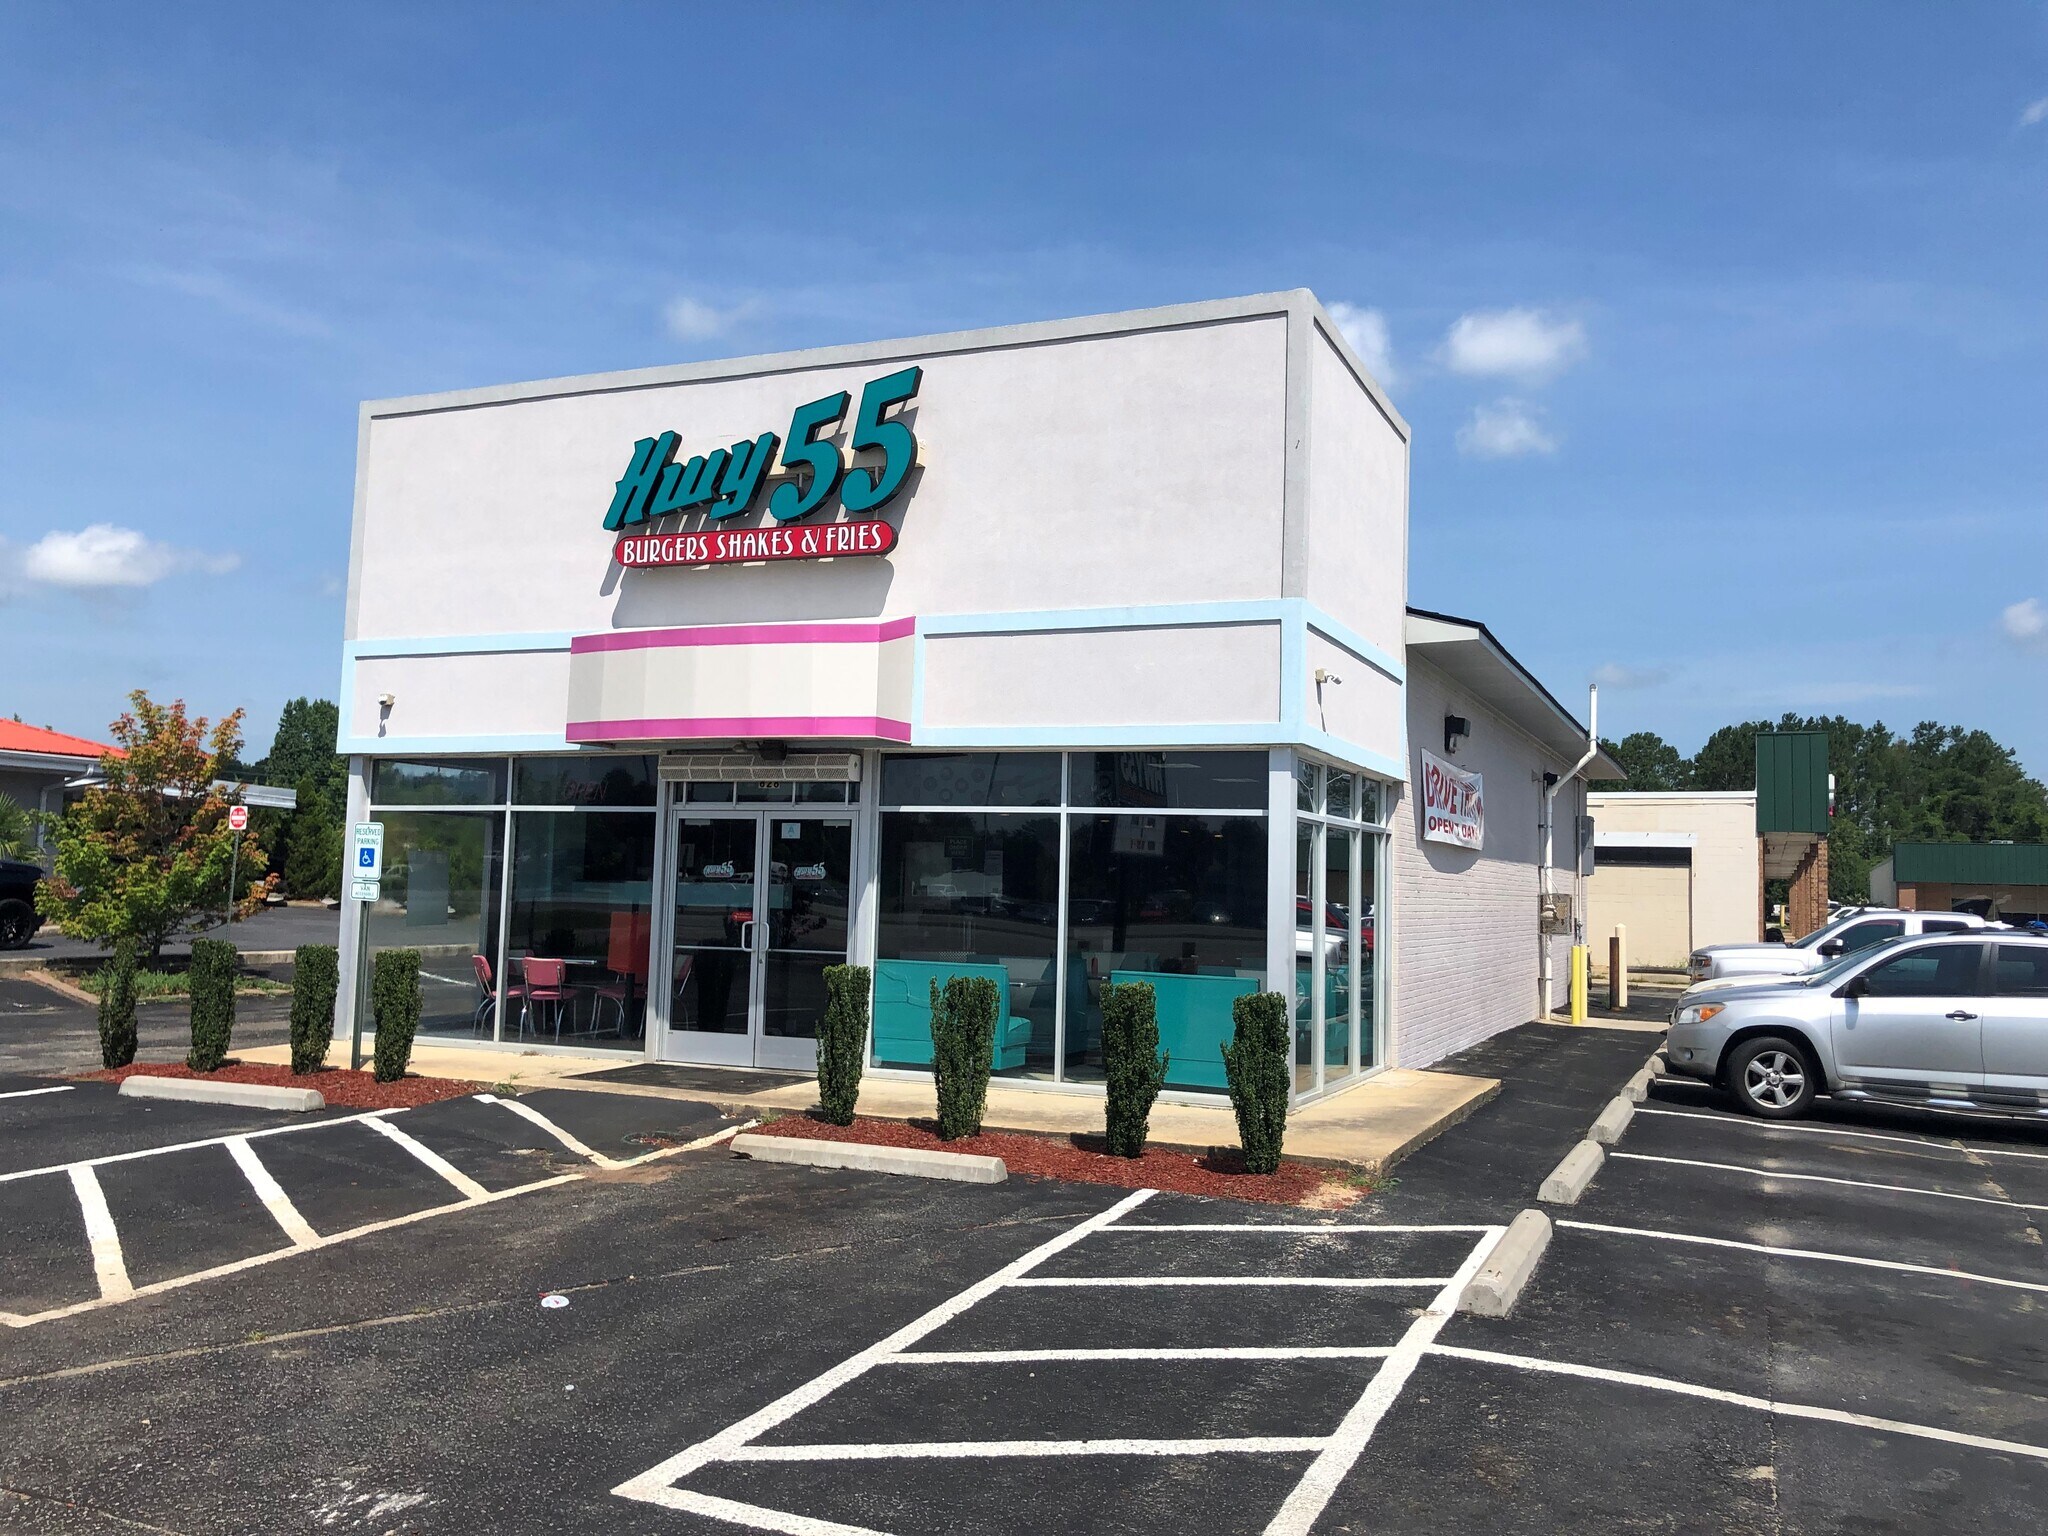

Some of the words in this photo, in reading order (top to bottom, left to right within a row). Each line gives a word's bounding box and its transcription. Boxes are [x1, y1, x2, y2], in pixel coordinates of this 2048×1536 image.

[603, 430, 781, 532] Hwy
[769, 366, 924, 523] 55
[623, 534, 708, 565] BURGERS
[715, 530, 794, 559] SHAKES
[801, 529, 819, 554] &
[826, 524, 883, 551] FRIES
[1425, 762, 1458, 815] DRIVE
[356, 827, 381, 836] RESERVED
[787, 825, 796, 834] A
[1428, 815, 1454, 835] OPEN
[357, 837, 379, 845] PARKING
